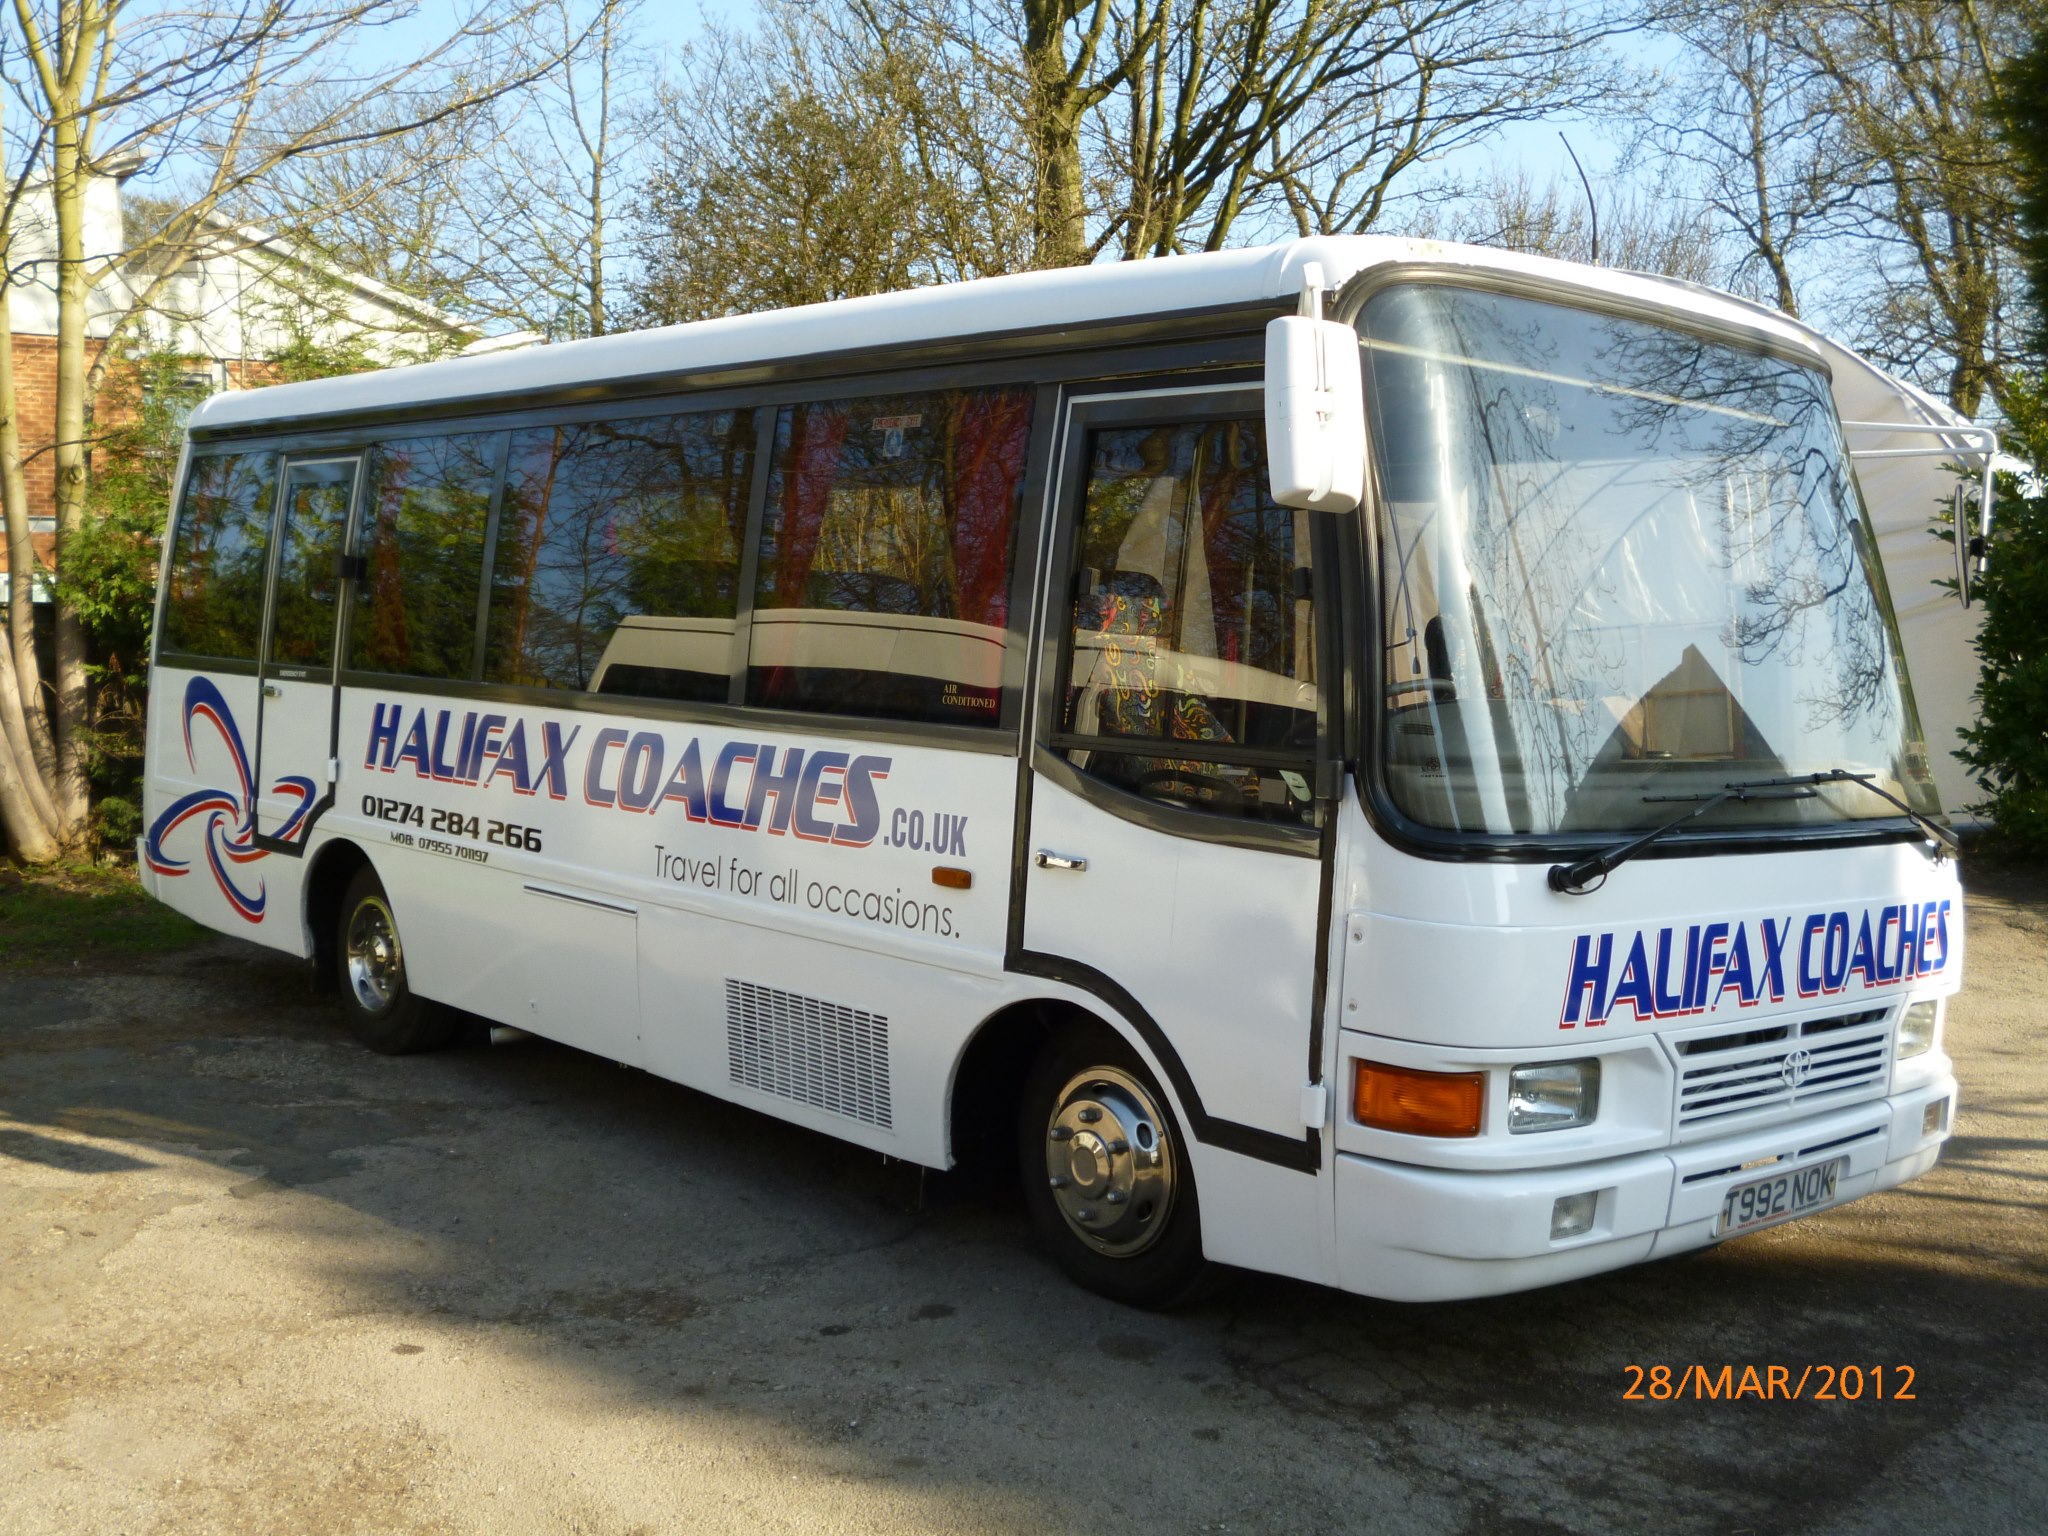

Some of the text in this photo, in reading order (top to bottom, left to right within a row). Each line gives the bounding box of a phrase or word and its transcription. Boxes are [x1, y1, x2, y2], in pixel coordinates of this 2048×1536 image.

[942, 695, 996, 708] CONDITIONED
[944, 684, 957, 693] AIR
[364, 702, 581, 801] HALIFAX
[583, 727, 893, 849] COACHES
[362, 794, 542, 853] 01274 284 266
[390, 831, 414, 847] MOB:
[418, 837, 452, 855] 07955
[654, 845, 960, 938] Travel for all occasions.
[1558, 899, 1951, 1030] HALIFAX COACHES
[1725, 1178, 1788, 1227] T992
[1791, 1162, 1836, 1209] NOK
